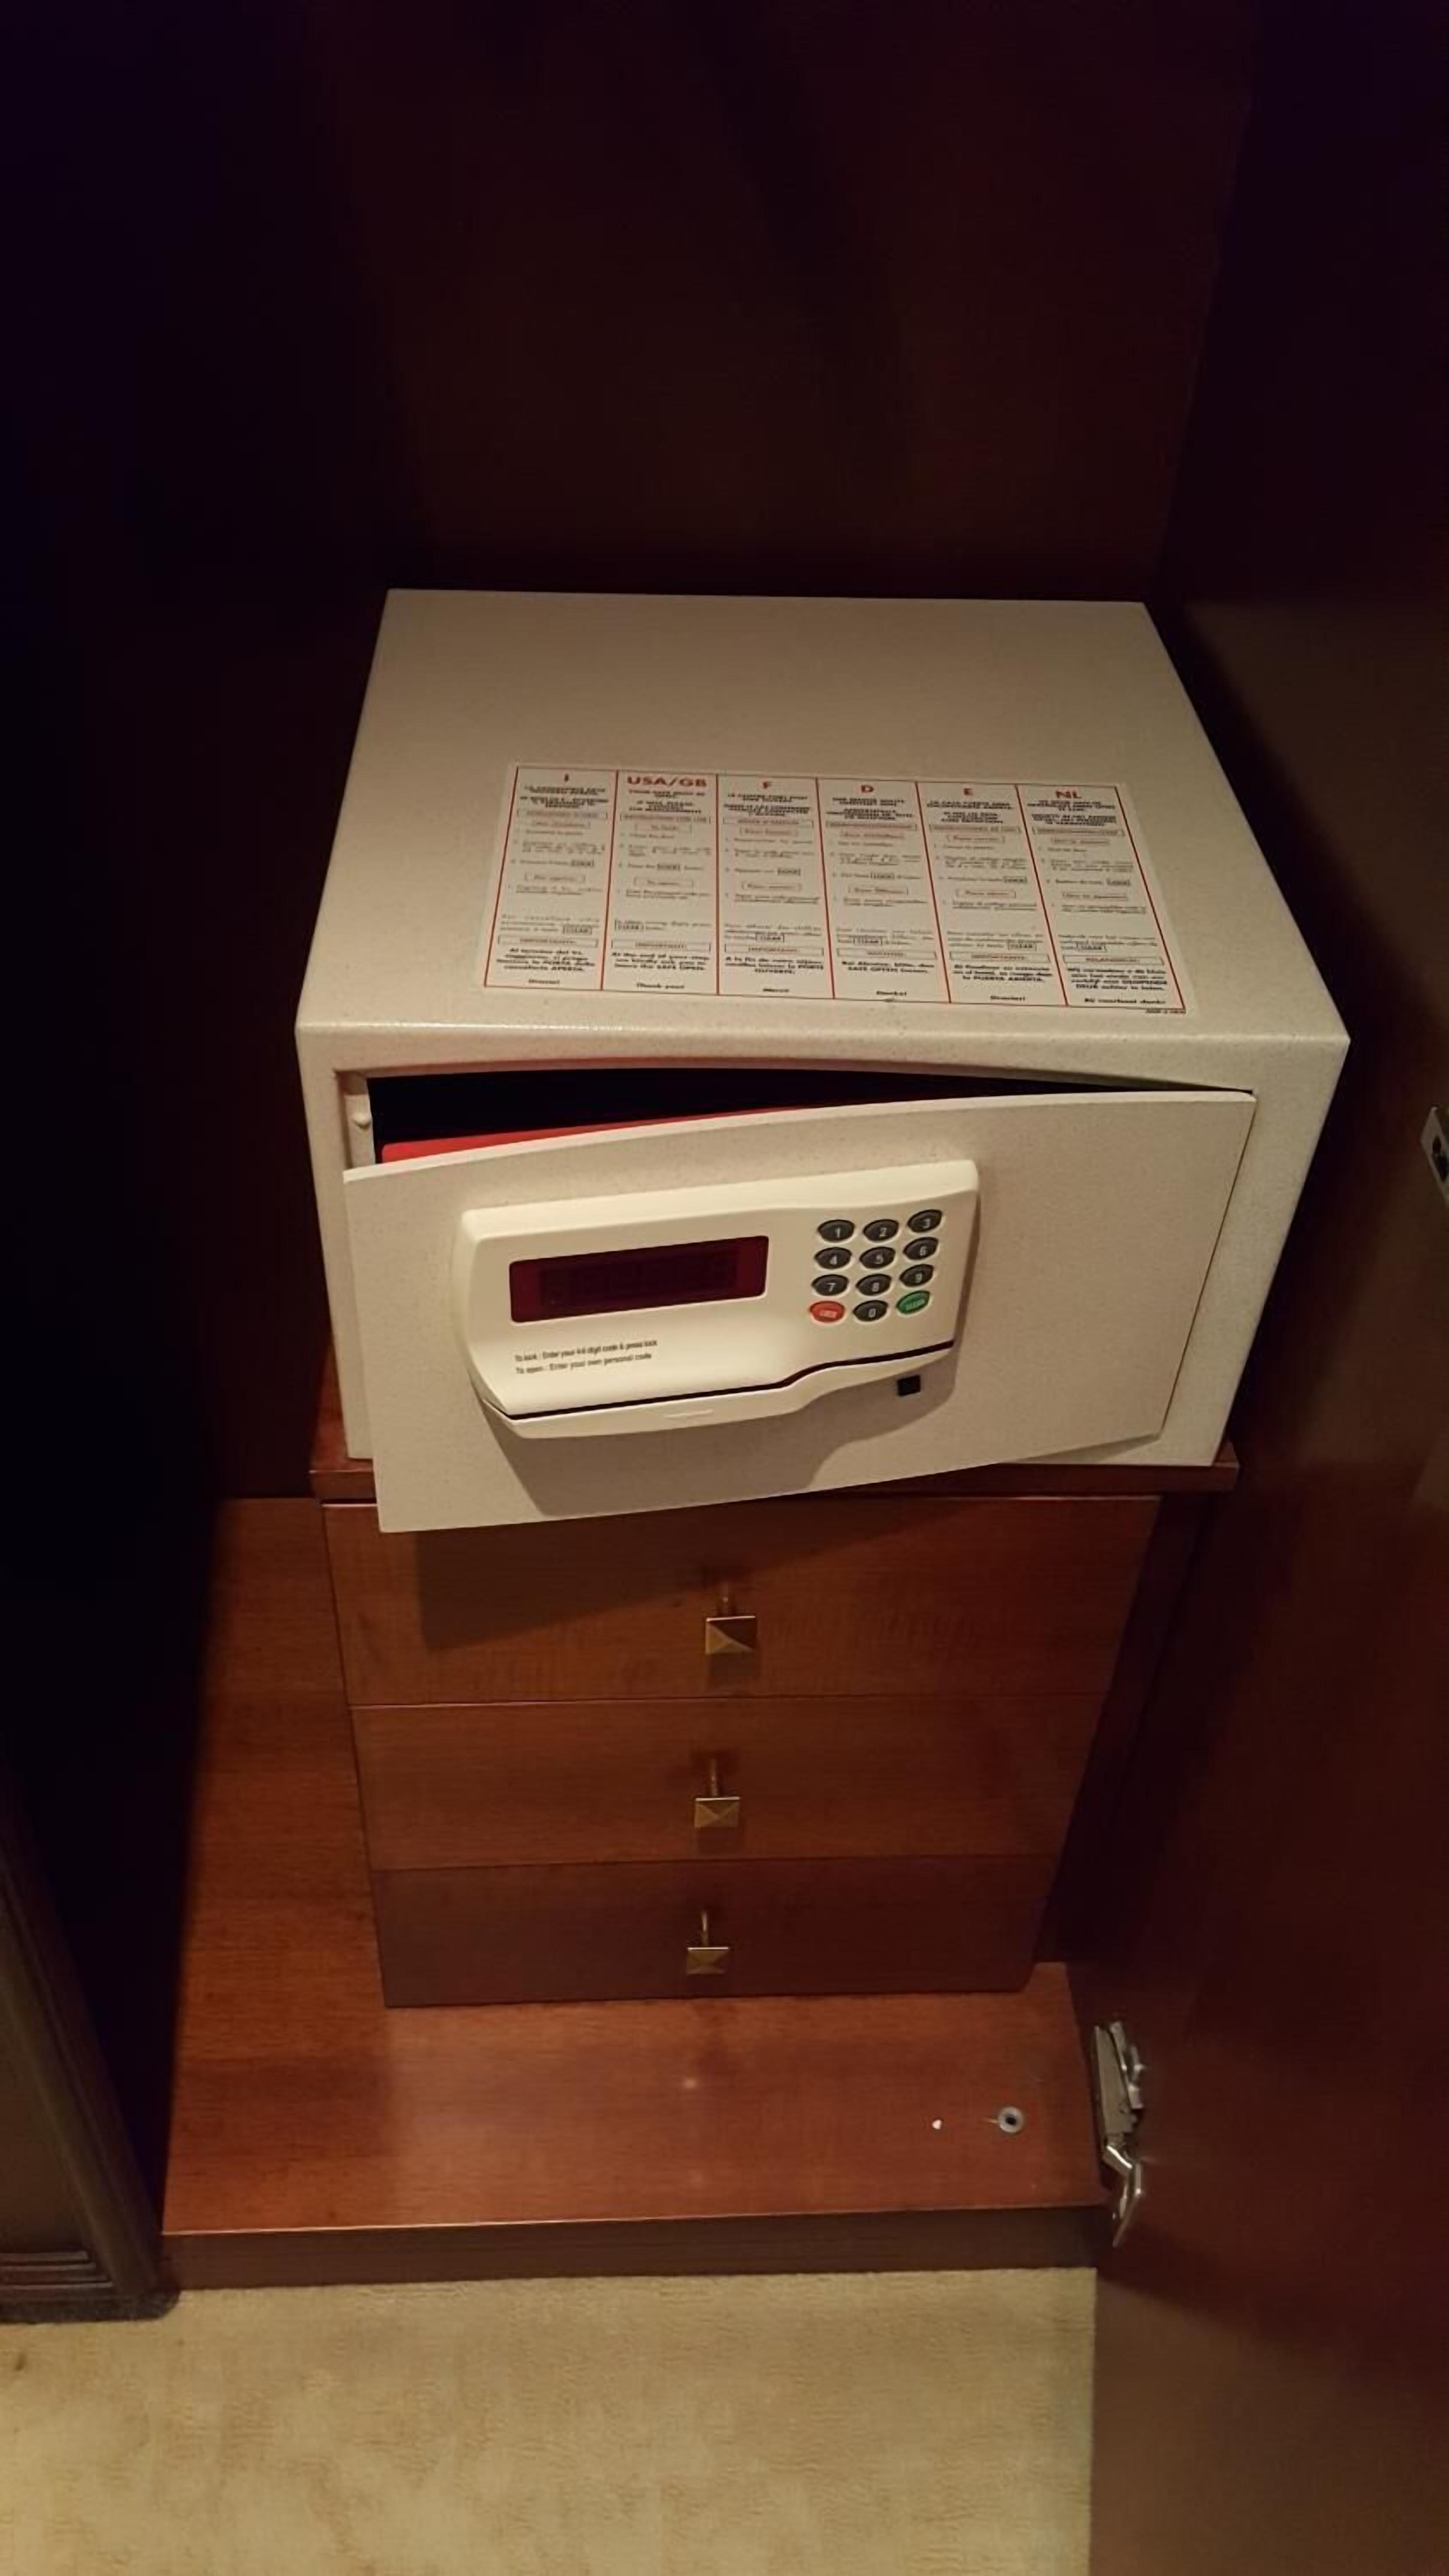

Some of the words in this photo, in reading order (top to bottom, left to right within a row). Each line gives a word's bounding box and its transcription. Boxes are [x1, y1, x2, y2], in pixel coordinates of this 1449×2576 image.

[627, 776, 706, 787] USA/GB
[763, 781, 771, 789] F
[861, 784, 874, 793] D
[1056, 790, 1082, 799] NL
[835, 1227, 841, 1238] 1
[879, 1227, 887, 1237] 2
[922, 1218, 930, 1228] 3
[829, 1255, 837, 1265] 4
[876, 1255, 884, 1264] 5
[919, 1246, 926, 1256] 6
[825, 1282, 836, 1292] 7
[872, 1282, 879, 1292] 8
[915, 1272, 922, 1283] 9
[868, 1308, 876, 1318] 0
[543, 1351, 559, 1359] Enter
[561, 1350, 575, 1358] your
[516, 1366, 524, 1374] To
[549, 1363, 568, 1371] Enter
[570, 1361, 586, 1370] your
[604, 1354, 634, 1366] personal
